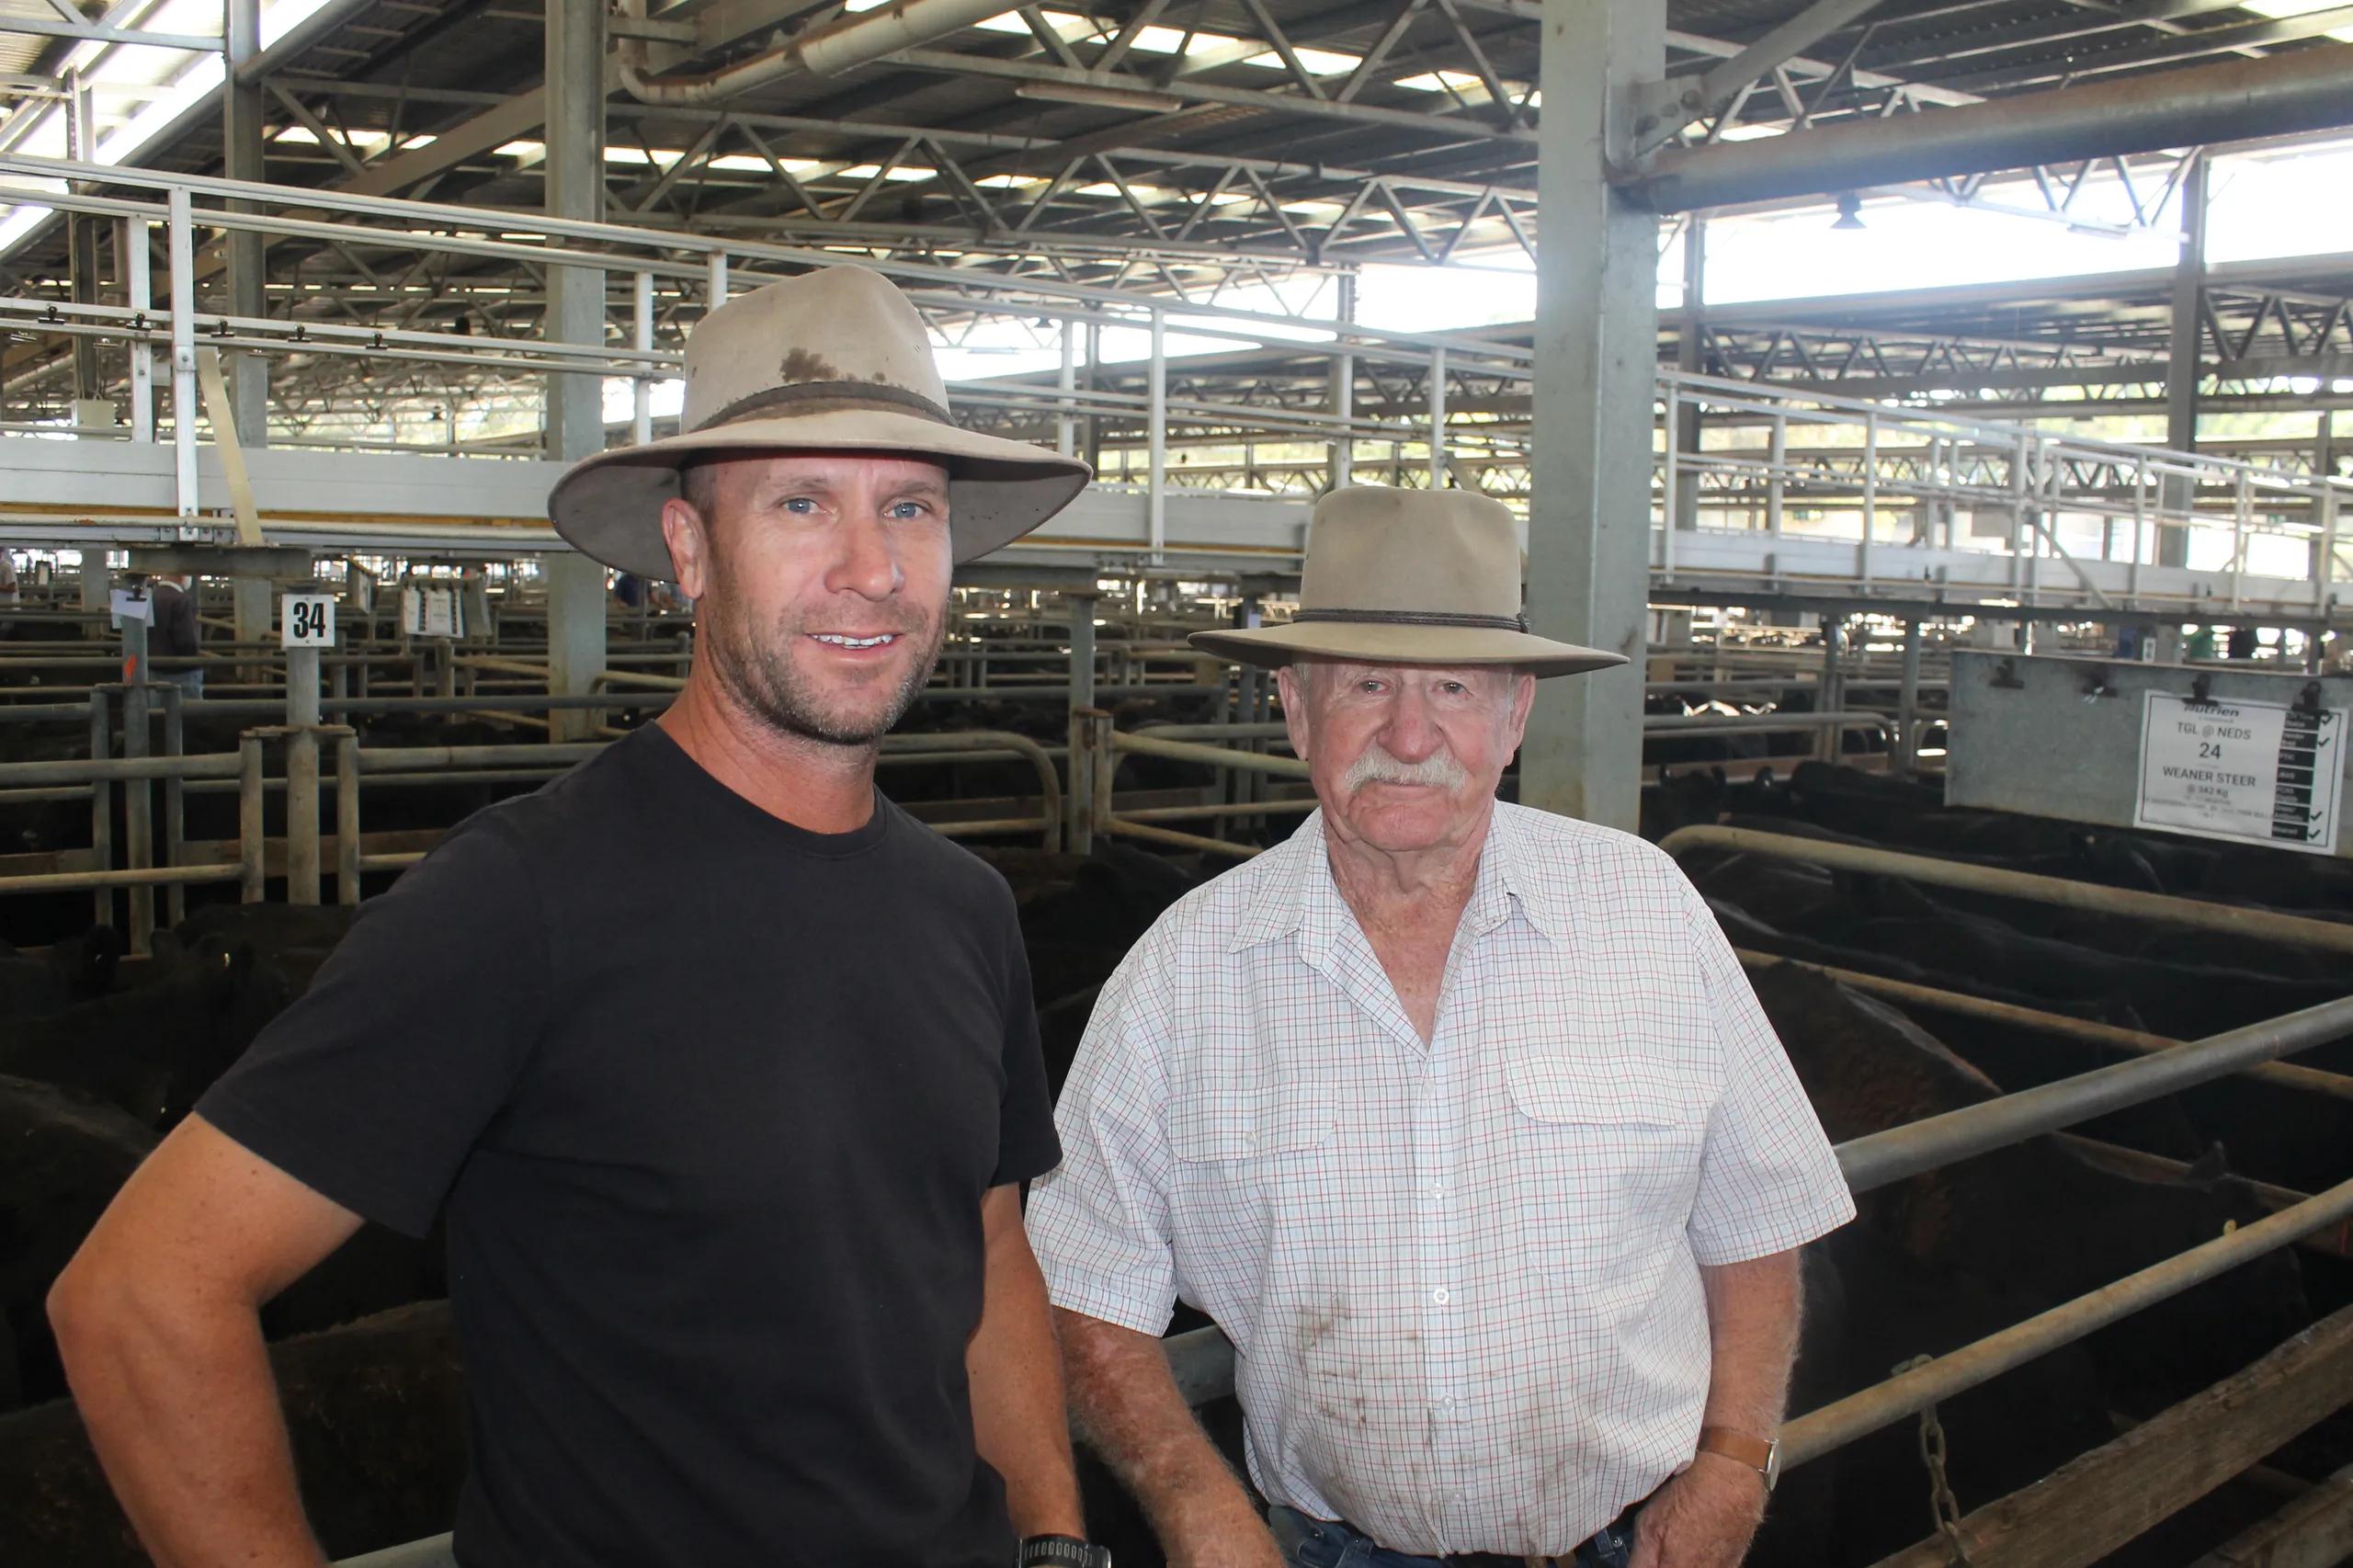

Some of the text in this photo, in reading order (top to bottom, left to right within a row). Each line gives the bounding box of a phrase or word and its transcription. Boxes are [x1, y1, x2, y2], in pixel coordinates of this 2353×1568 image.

[293, 601, 325, 639] 34
[2177, 722, 2199, 735] TGL
[2217, 726, 2252, 741] NEDS
[2199, 742, 2222, 760] 24
[2163, 765, 2213, 781] WEANER
[2216, 772, 2256, 787] STEER
